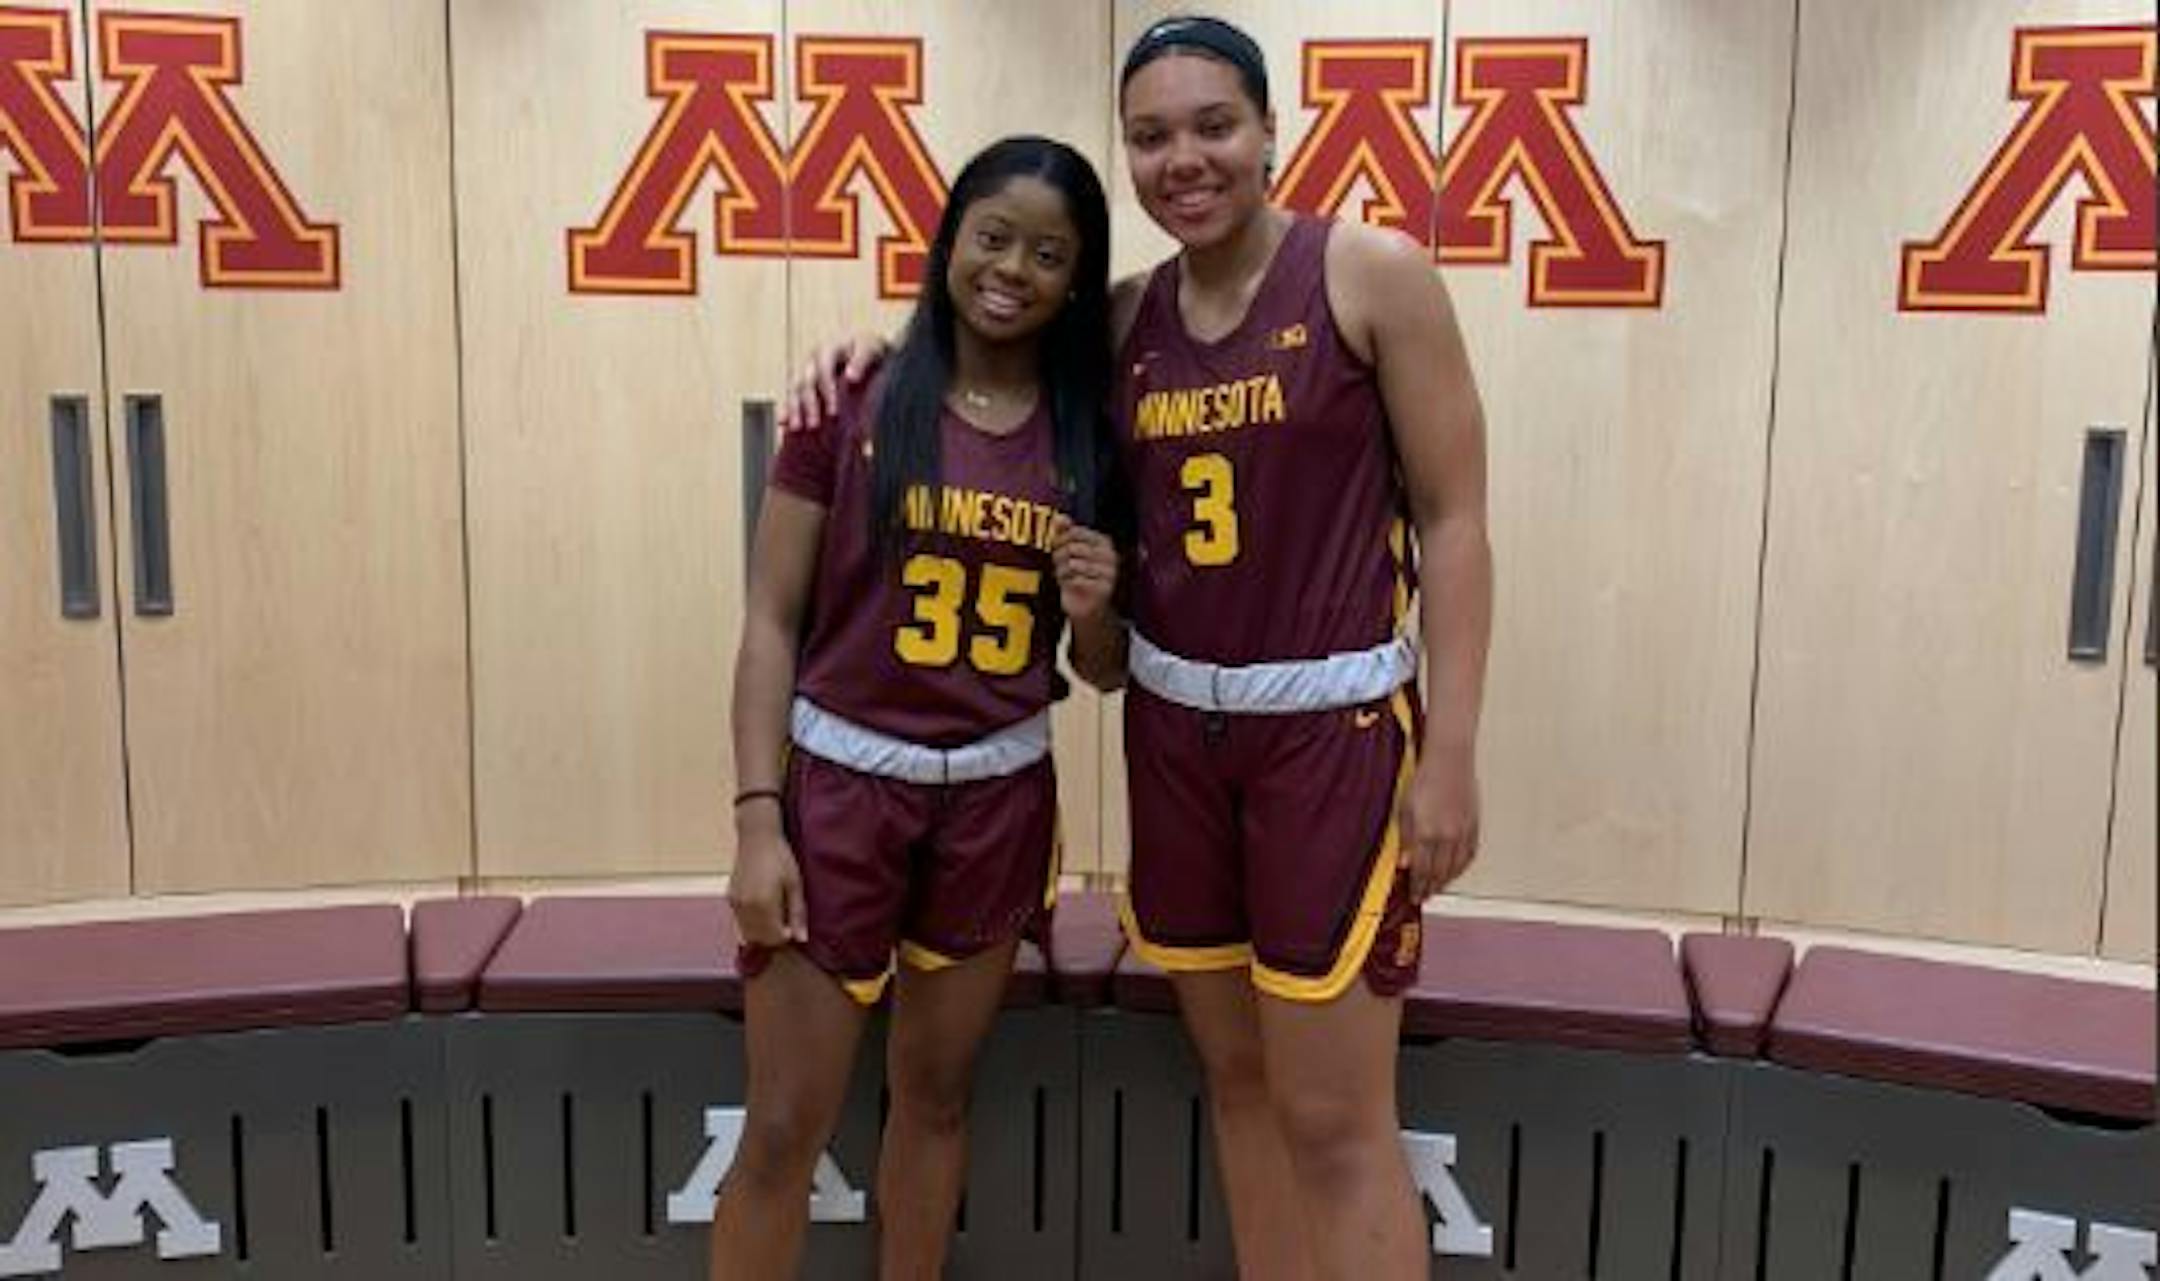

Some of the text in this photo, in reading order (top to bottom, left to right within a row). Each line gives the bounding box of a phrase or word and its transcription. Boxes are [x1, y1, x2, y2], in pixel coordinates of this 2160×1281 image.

[0, 7, 339, 289] M
[567, 30, 957, 300] M
[1268, 37, 1665, 308] M
[1180, 452, 1239, 566] 3
[894, 553, 1041, 675] 35
[0, 1137, 221, 1277] M
